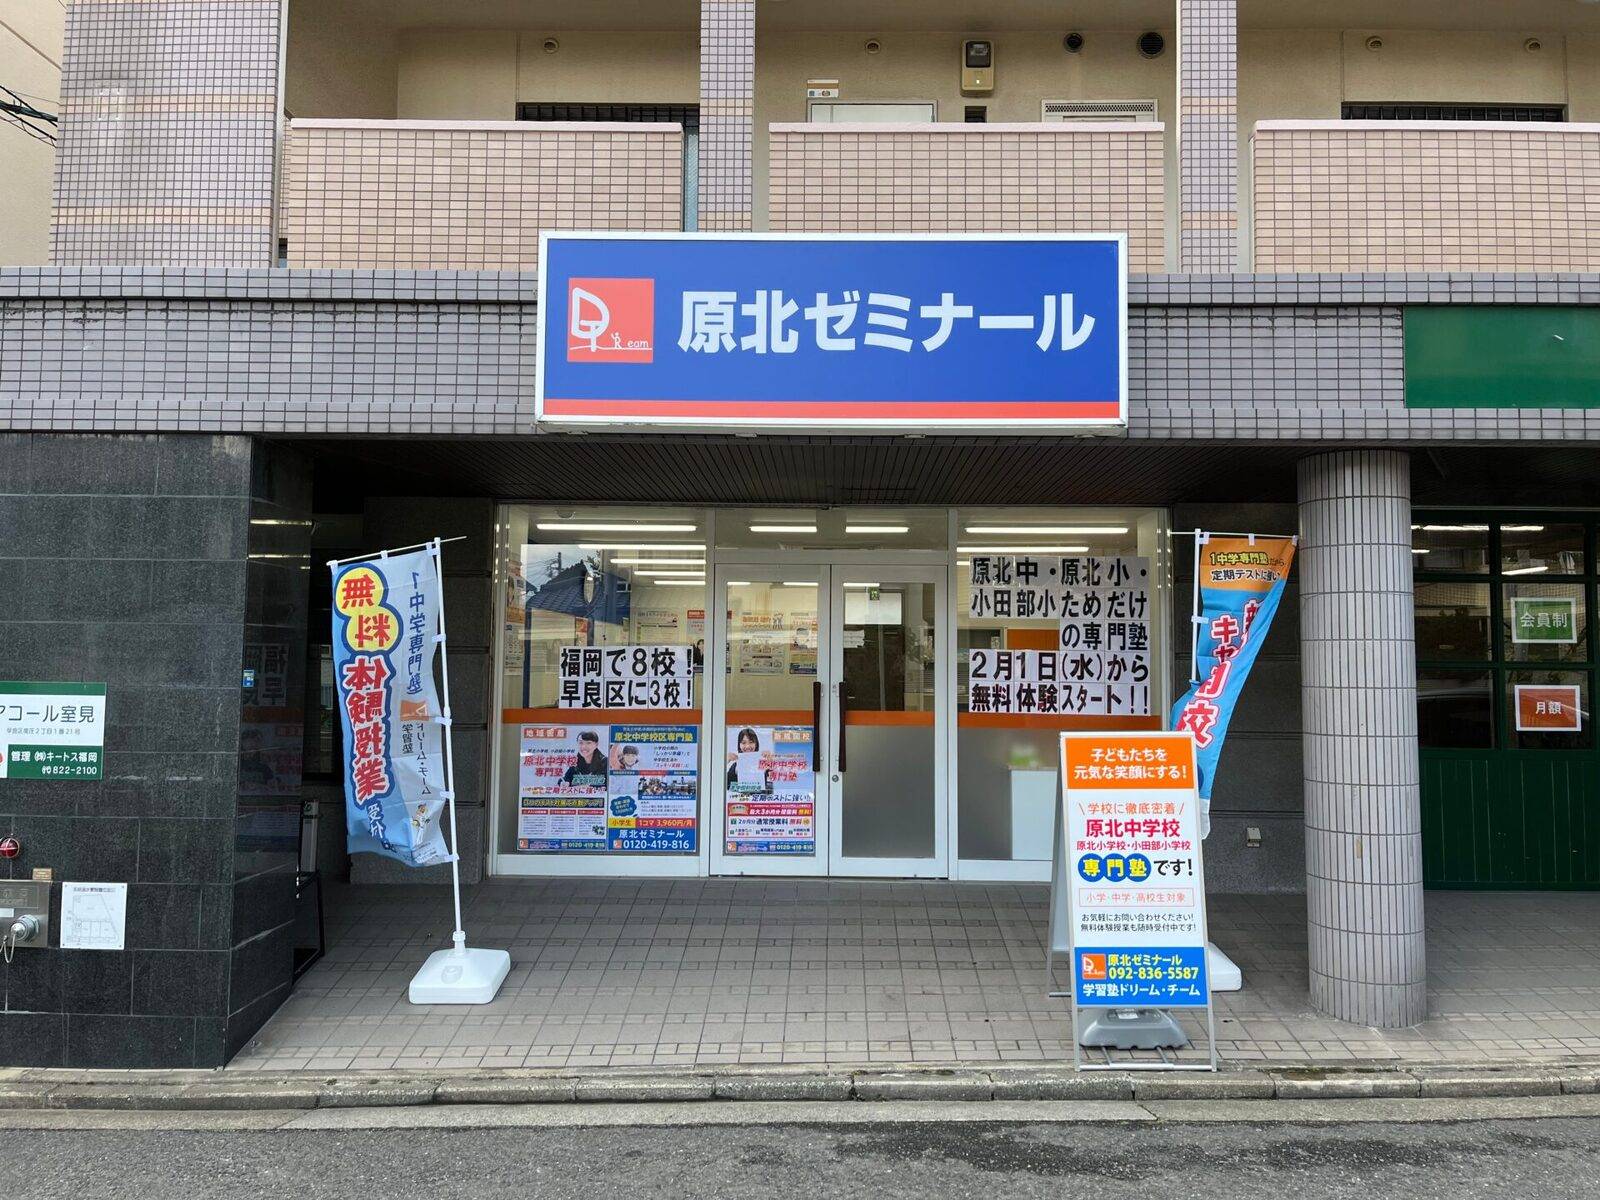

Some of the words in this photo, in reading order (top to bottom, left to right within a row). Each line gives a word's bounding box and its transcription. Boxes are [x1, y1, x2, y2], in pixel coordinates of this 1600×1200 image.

[677, 288, 1096, 354] 原北ゼミナール
[971, 588, 1147, 619] 小田部小ためだけ
[1520, 612, 1568, 628] 会員制
[1061, 622, 1148, 651] の専門塾
[560, 647, 693, 677] 福岡で8校!
[971, 651, 1149, 682] 2月1日(水)から
[560, 679, 693, 709] 早良区に3校!
[971, 684, 1149, 715] 無料体験スタート!!
[1535, 701, 1562, 715] 月額
[614, 733, 694, 742] 原北中学校区専門塾
[11, 750, 31, 762] 管理
[523, 755, 578, 767] 原北中学校
[1090, 748, 1168, 762] 子どもたちを
[1074, 765, 1188, 779] 元気な笑顔にする!
[1087, 802, 1176, 815] 学校に徹底密着
[619, 829, 685, 839] 原北ゼミナール
[1086, 818, 1181, 838] 原北中学校
[623, 840, 690, 849] 0120-419-816
[1076, 840, 1192, 851] 原北小学校・小田部小学校
[1081, 913, 1194, 922] お気軽にお問い合わせください!
[1080, 923, 1197, 932] 無料体験授業も随時受付中です!
[1107, 954, 1183, 967] 原北ゼミナール
[1108, 967, 1199, 980] 092-836-5587
[1082, 983, 1201, 997] 学習塾ドリーム・チーム
